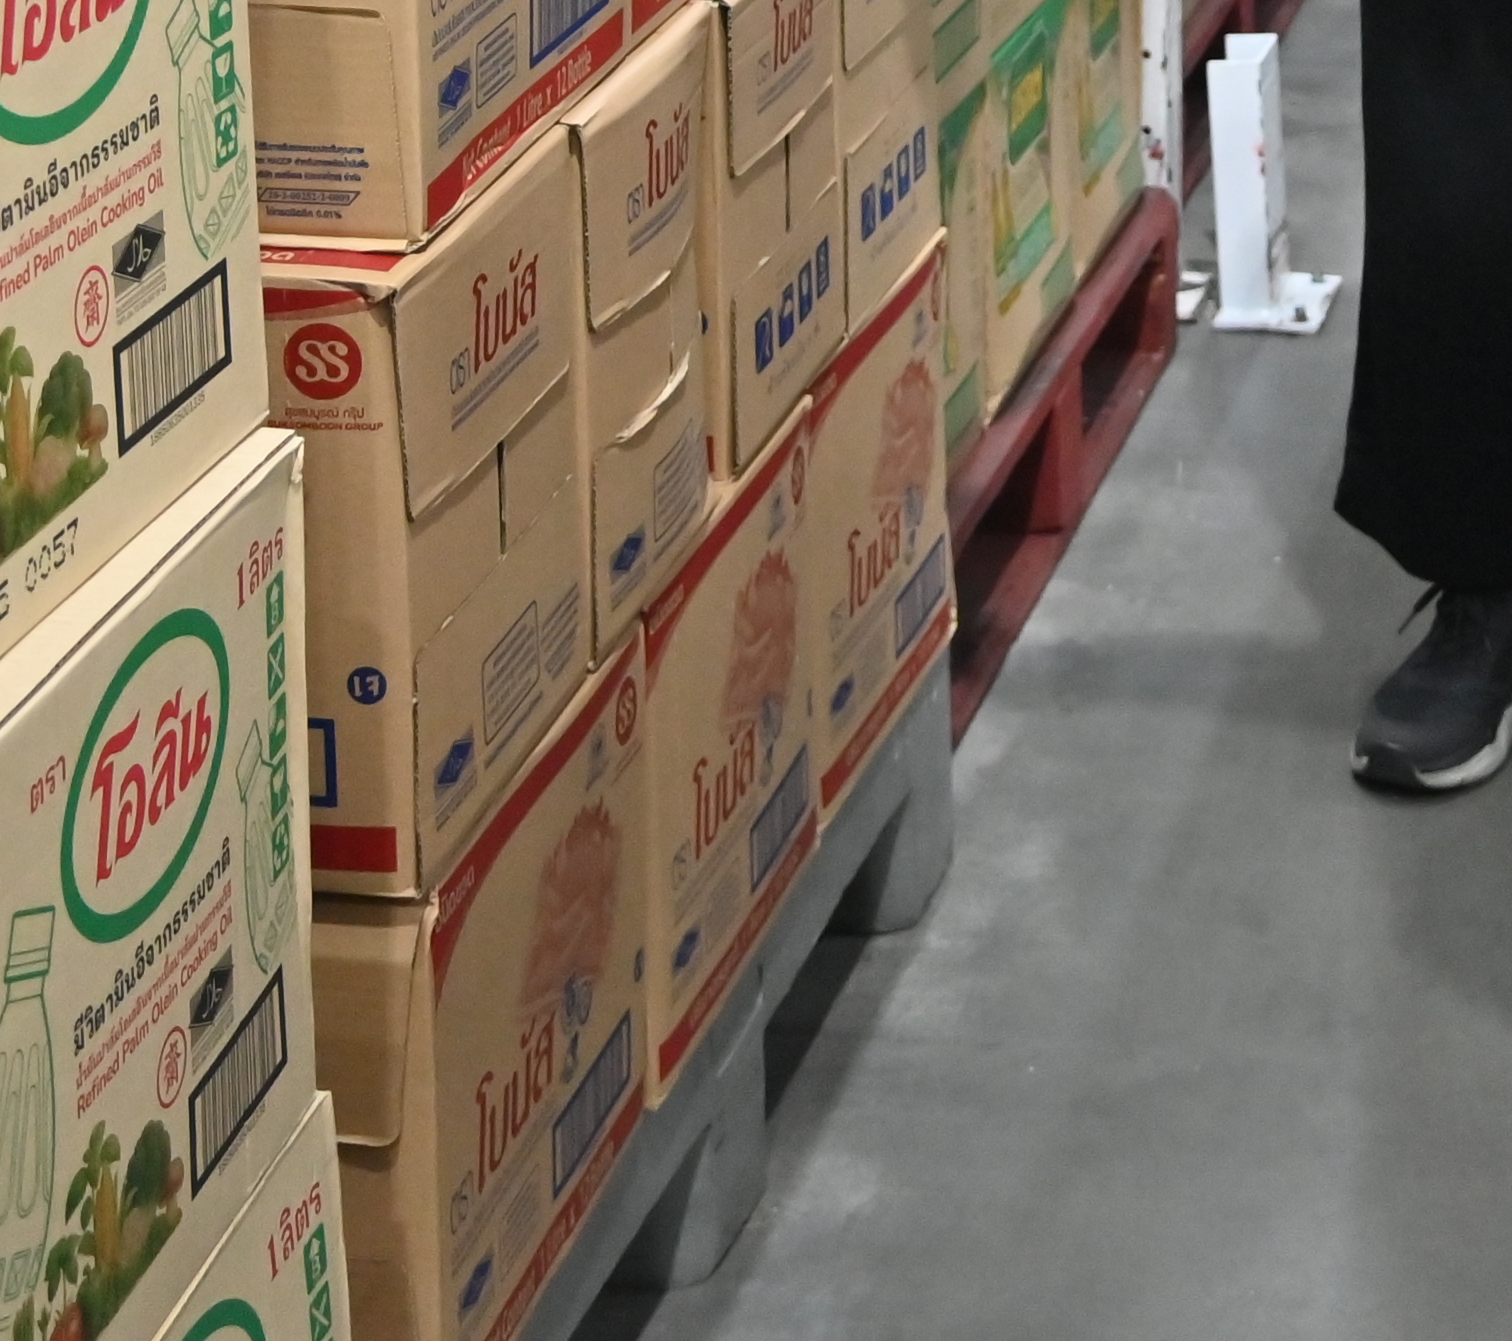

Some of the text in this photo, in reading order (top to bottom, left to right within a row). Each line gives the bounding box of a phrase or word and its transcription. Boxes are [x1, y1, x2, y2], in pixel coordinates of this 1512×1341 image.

[33, 246, 65, 280] Palm
[66, 218, 98, 253] Olein
[100, 184, 146, 229] Cooking
[147, 168, 165, 196] Oil
[294, 339, 350, 383] SS
[471, 248, 540, 377] โบนัส
[345, 422, 384, 432] GROUP
[23, 516, 81, 594] 0057
[235, 525, 285, 611] 1 ลิตร
[29, 686, 214, 889] ตรา โอลีน
[77, 905, 233, 1118] Refined Palm Olein Cooking Oil
[476, 1014, 556, 1196] โบนัส
[268, 1180, 322, 1281] 1 ลิตร
